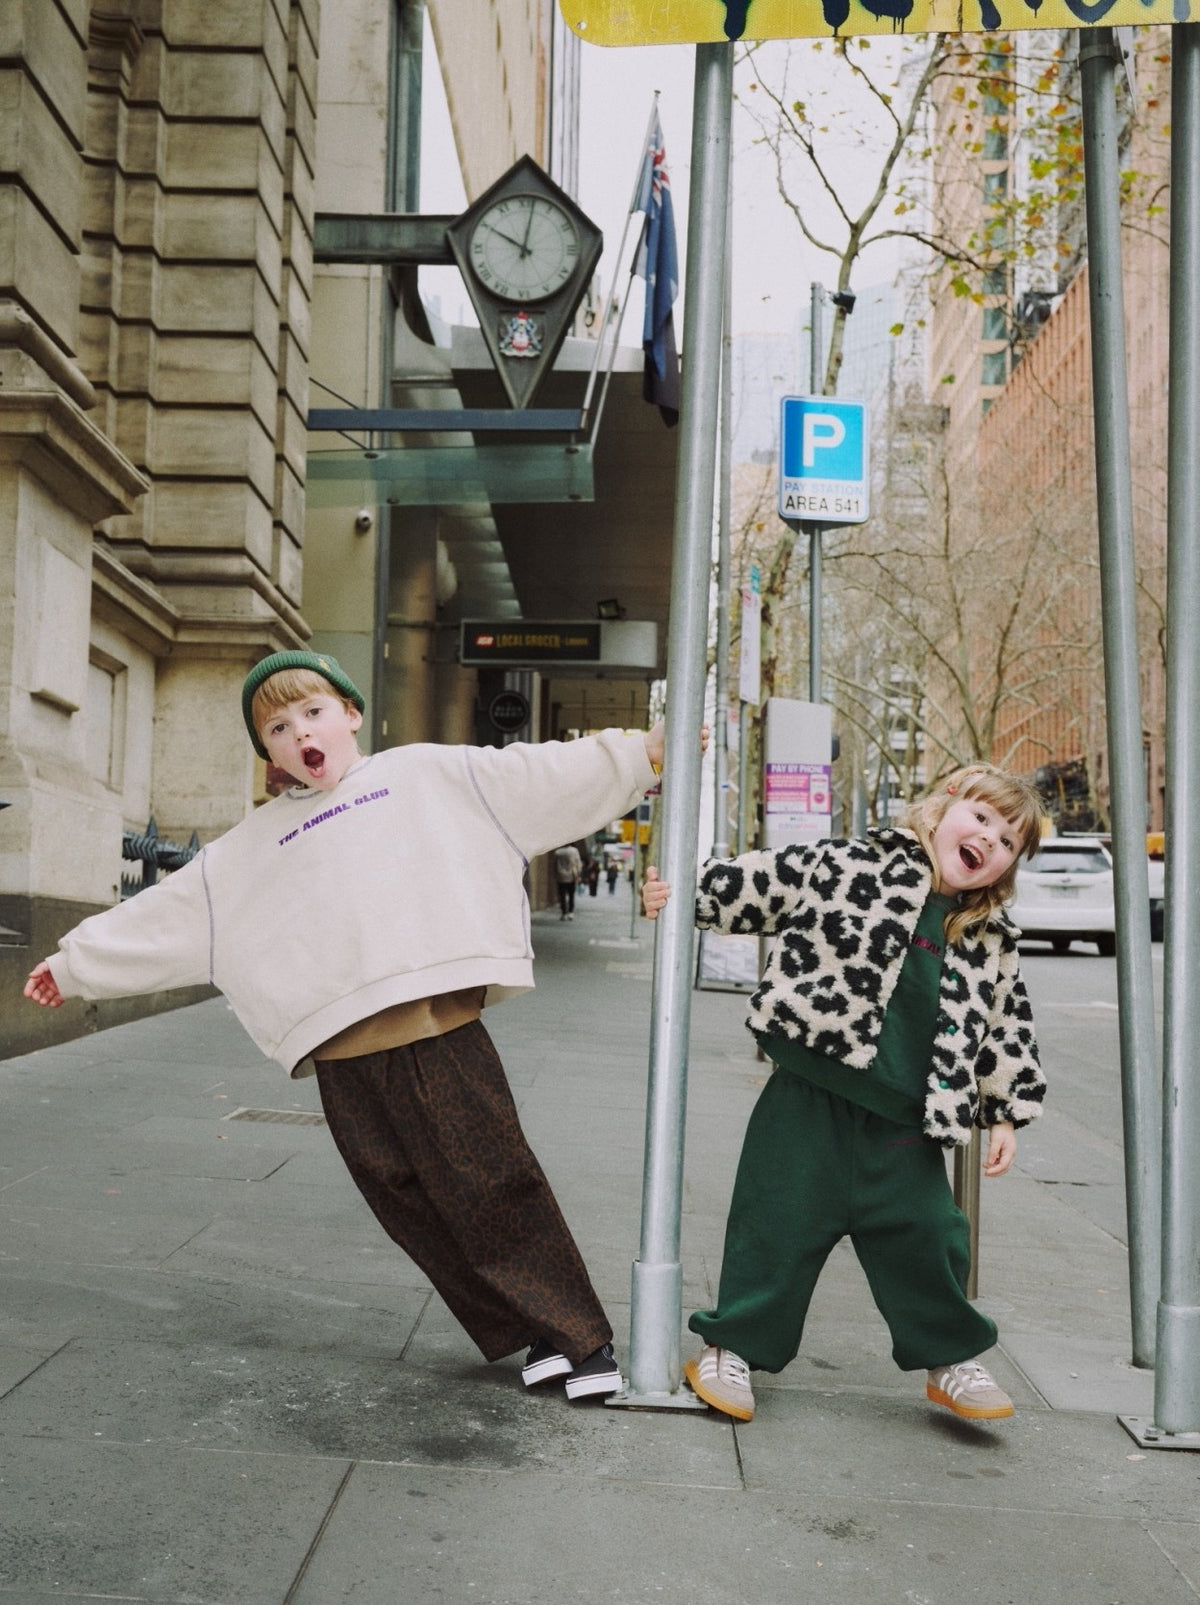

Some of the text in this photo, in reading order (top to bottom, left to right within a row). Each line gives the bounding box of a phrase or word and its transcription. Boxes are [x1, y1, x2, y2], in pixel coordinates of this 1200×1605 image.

[802, 412, 846, 467] P
[785, 482, 863, 496] PAY STATION
[785, 495, 860, 515] AREA 541
[497, 634, 523, 648] LOCAL
[525, 634, 560, 648] GROCER
[771, 764, 823, 774] PAY BY PHONE
[279, 788, 389, 846] THE ANIMAL CLUB
